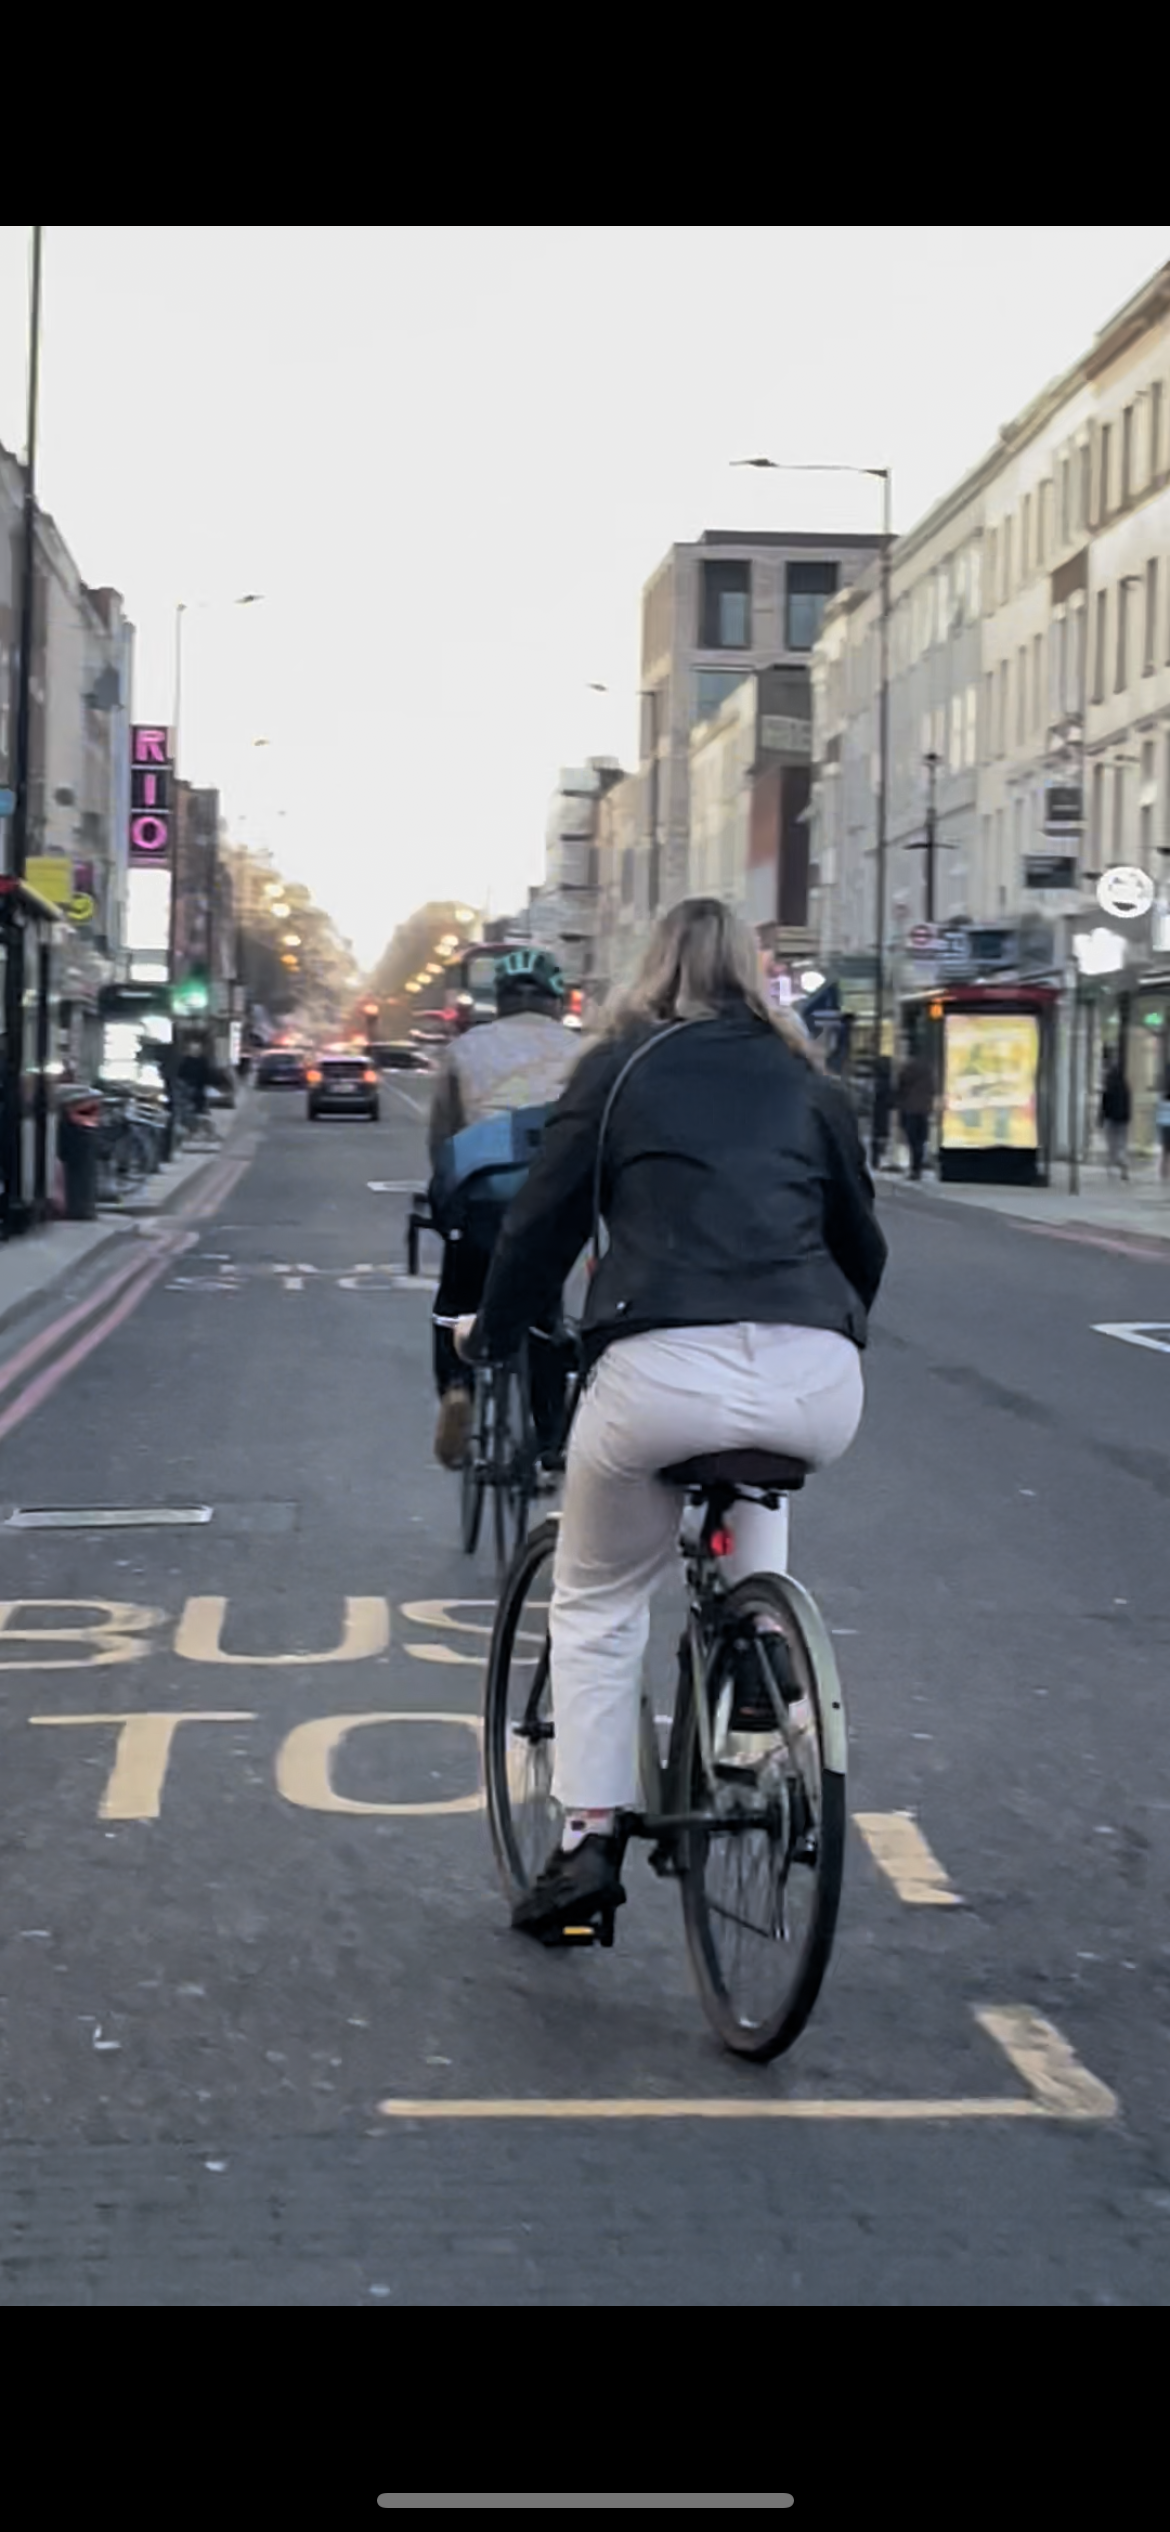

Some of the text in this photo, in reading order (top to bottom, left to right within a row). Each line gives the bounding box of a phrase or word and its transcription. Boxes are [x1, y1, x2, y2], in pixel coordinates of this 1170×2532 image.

[132, 729, 168, 849] RIO
[0, 1595, 553, 1668] BUS
[28, 1711, 555, 1819] TO
